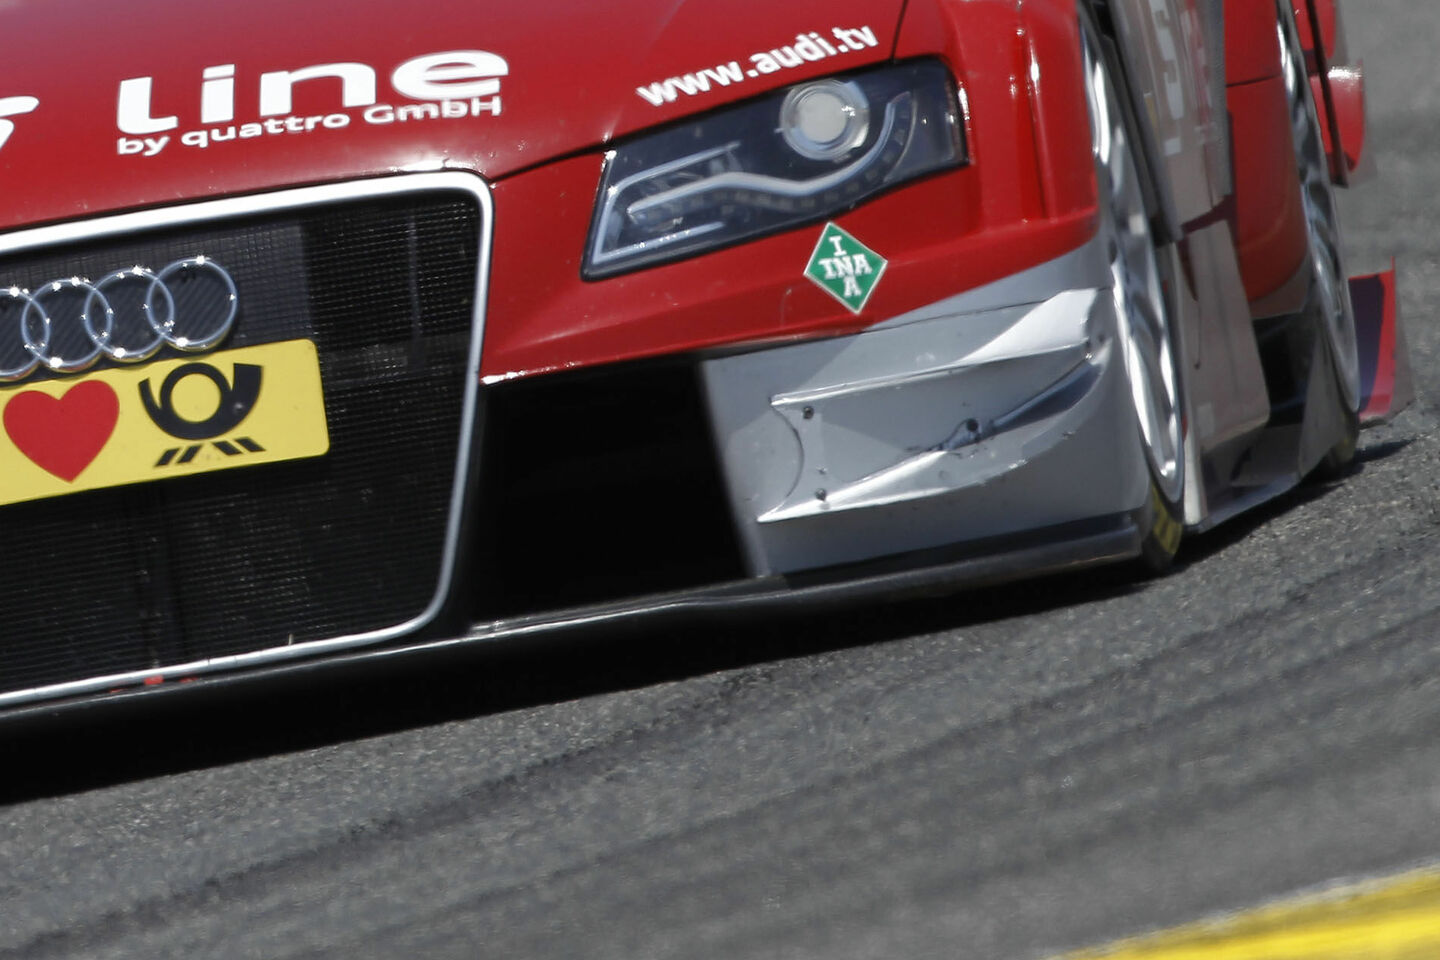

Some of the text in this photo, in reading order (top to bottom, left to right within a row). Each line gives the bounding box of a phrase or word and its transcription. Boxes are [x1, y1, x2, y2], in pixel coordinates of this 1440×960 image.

[636, 25, 880, 107] www.audi.tv
[116, 95, 502, 157] by quattro GmbH
